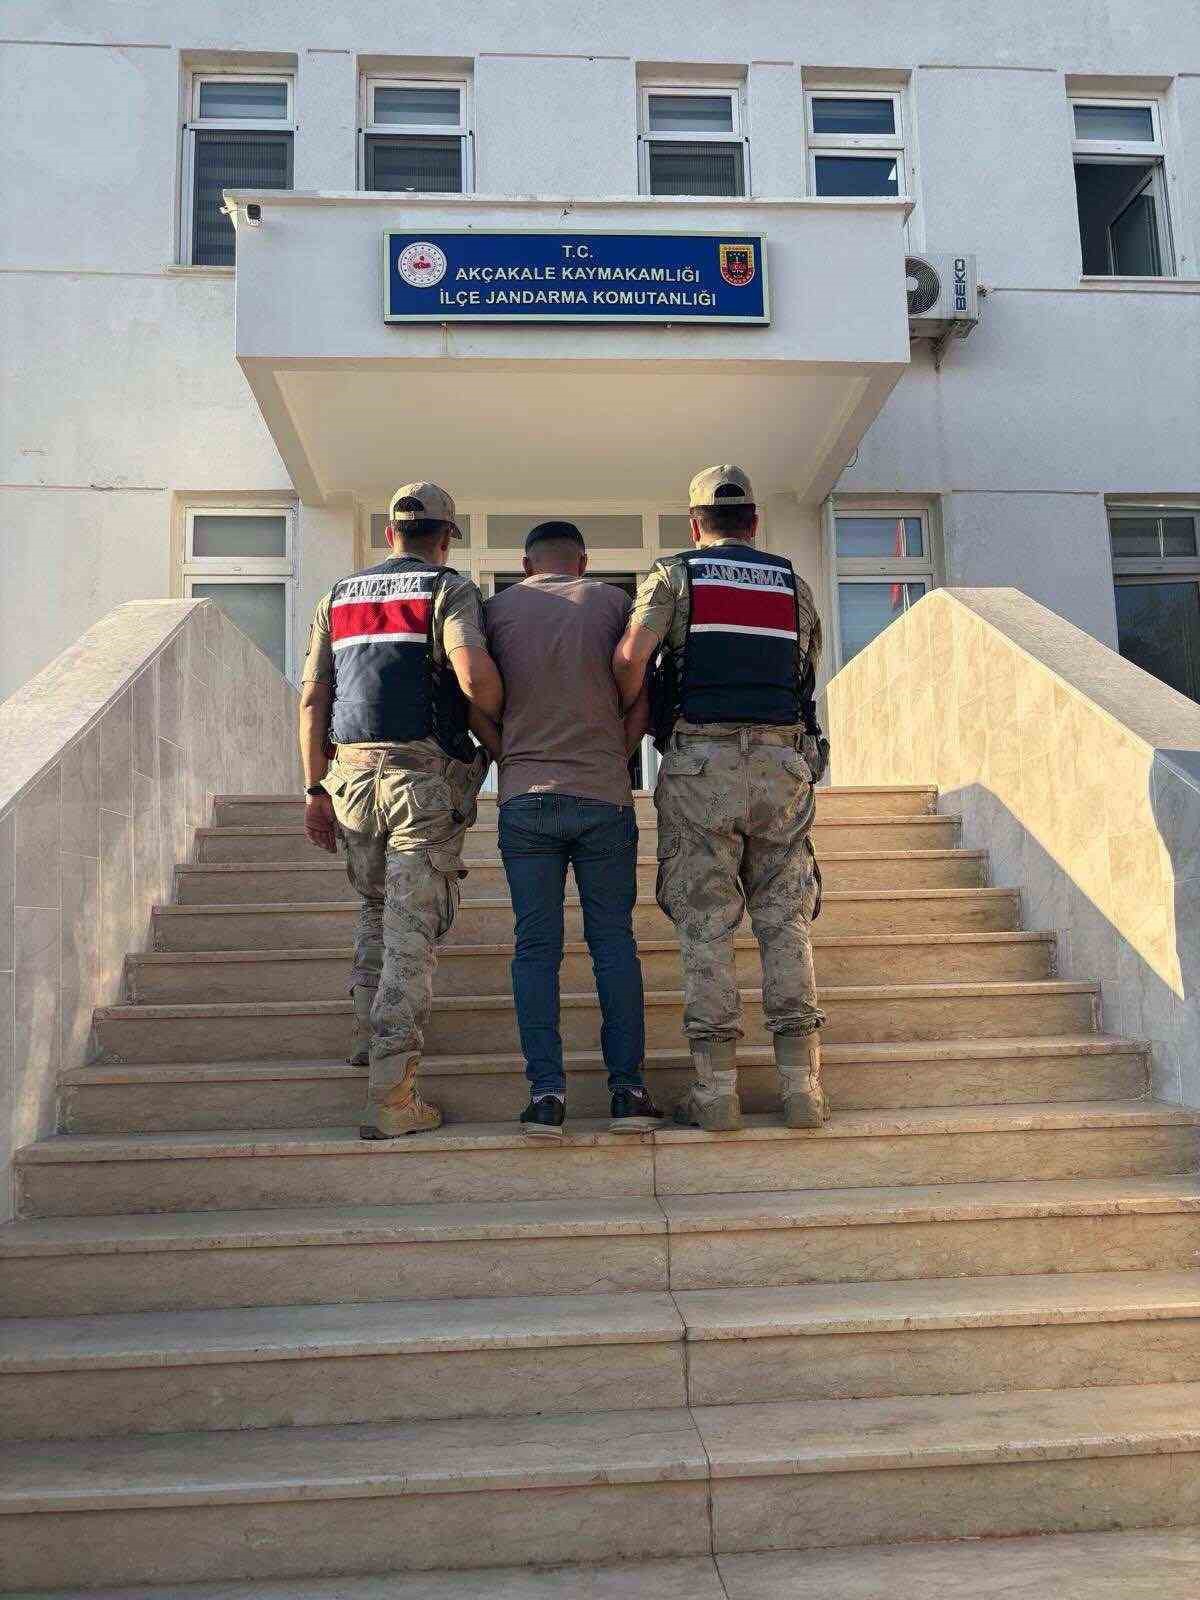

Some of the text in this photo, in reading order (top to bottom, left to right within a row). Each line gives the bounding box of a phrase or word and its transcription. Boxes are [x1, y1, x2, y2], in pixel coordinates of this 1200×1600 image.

[562, 245, 593, 258] T.C.
[456, 267, 556, 283] AKÇAKALE
[562, 265, 700, 283] KAYMAKAMLIĞI
[955, 258, 967, 311] BEKO
[440, 289, 716, 306] İLÇE JANDARMA KOMUTANLIĞI
[702, 564, 786, 587] JANDARMA
[343, 577, 422, 598] JANDARMA
